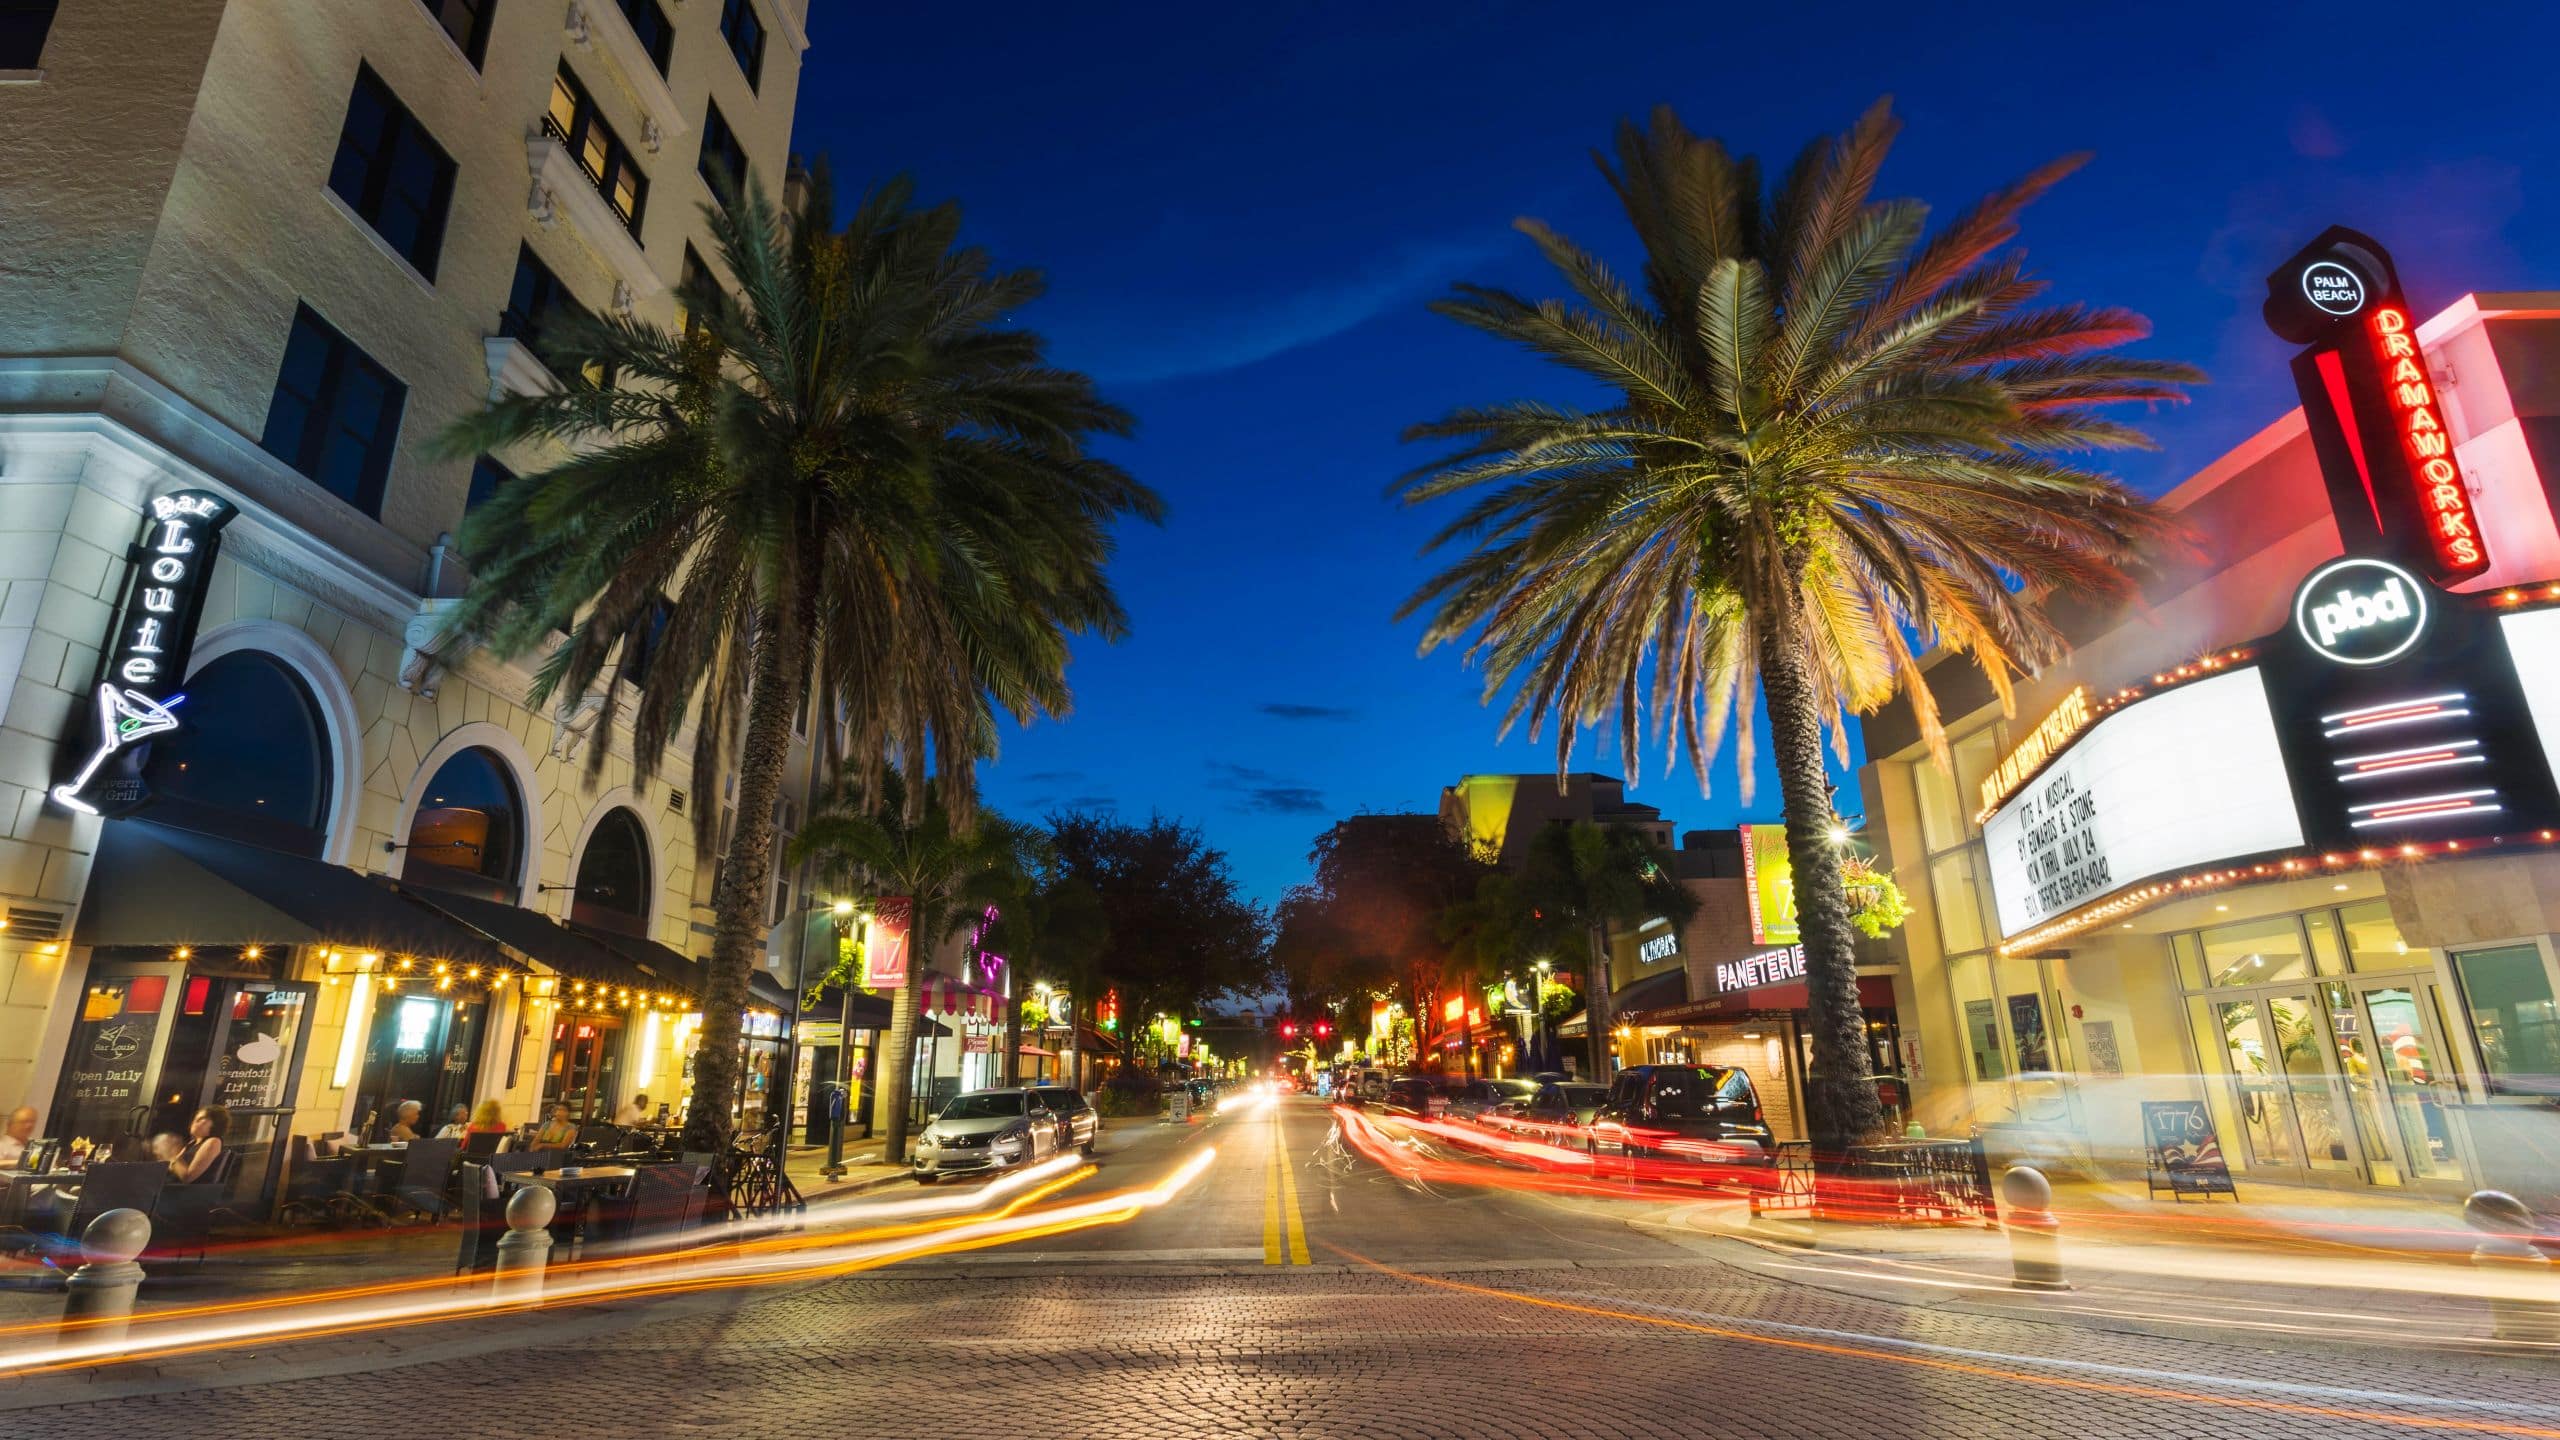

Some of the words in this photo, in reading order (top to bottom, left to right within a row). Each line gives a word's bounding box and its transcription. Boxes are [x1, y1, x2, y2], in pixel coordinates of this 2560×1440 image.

[2313, 276, 2349, 288] PALM
[2313, 290, 2358, 301] BEACH
[2375, 308, 2479, 564] DRAMAWORKS
[152, 495, 222, 520] Bar
[121, 519, 195, 684] Louie
[2312, 577, 2411, 646] pbd
[2020, 802, 2034, 830] 1776
[2037, 795, 2043, 819] A
[2044, 771, 2075, 810] MUSICAL
[2017, 837, 2027, 861] BY
[2027, 815, 2058, 855] EDWARDS
[2059, 810, 2067, 834] &
[2068, 789, 2097, 828] STONE
[1744, 832, 1757, 878] PARADISE
[2040, 847, 2061, 879] THRU
[2062, 834, 2083, 868] JULY
[2082, 826, 2097, 855] 24
[1747, 879, 1759, 893] IN
[2038, 881, 2062, 913] OFFICE
[1750, 892, 1764, 936] SUMMER
[1717, 944, 1808, 992] PANETERIE
[401, 1050, 429, 1064] Drink
[72, 1071, 103, 1083] Open
[105, 1070, 143, 1083] Daily
[76, 1088, 92, 1097] at
[111, 1088, 129, 1097] am
[2156, 1105, 2204, 1132] 1776
